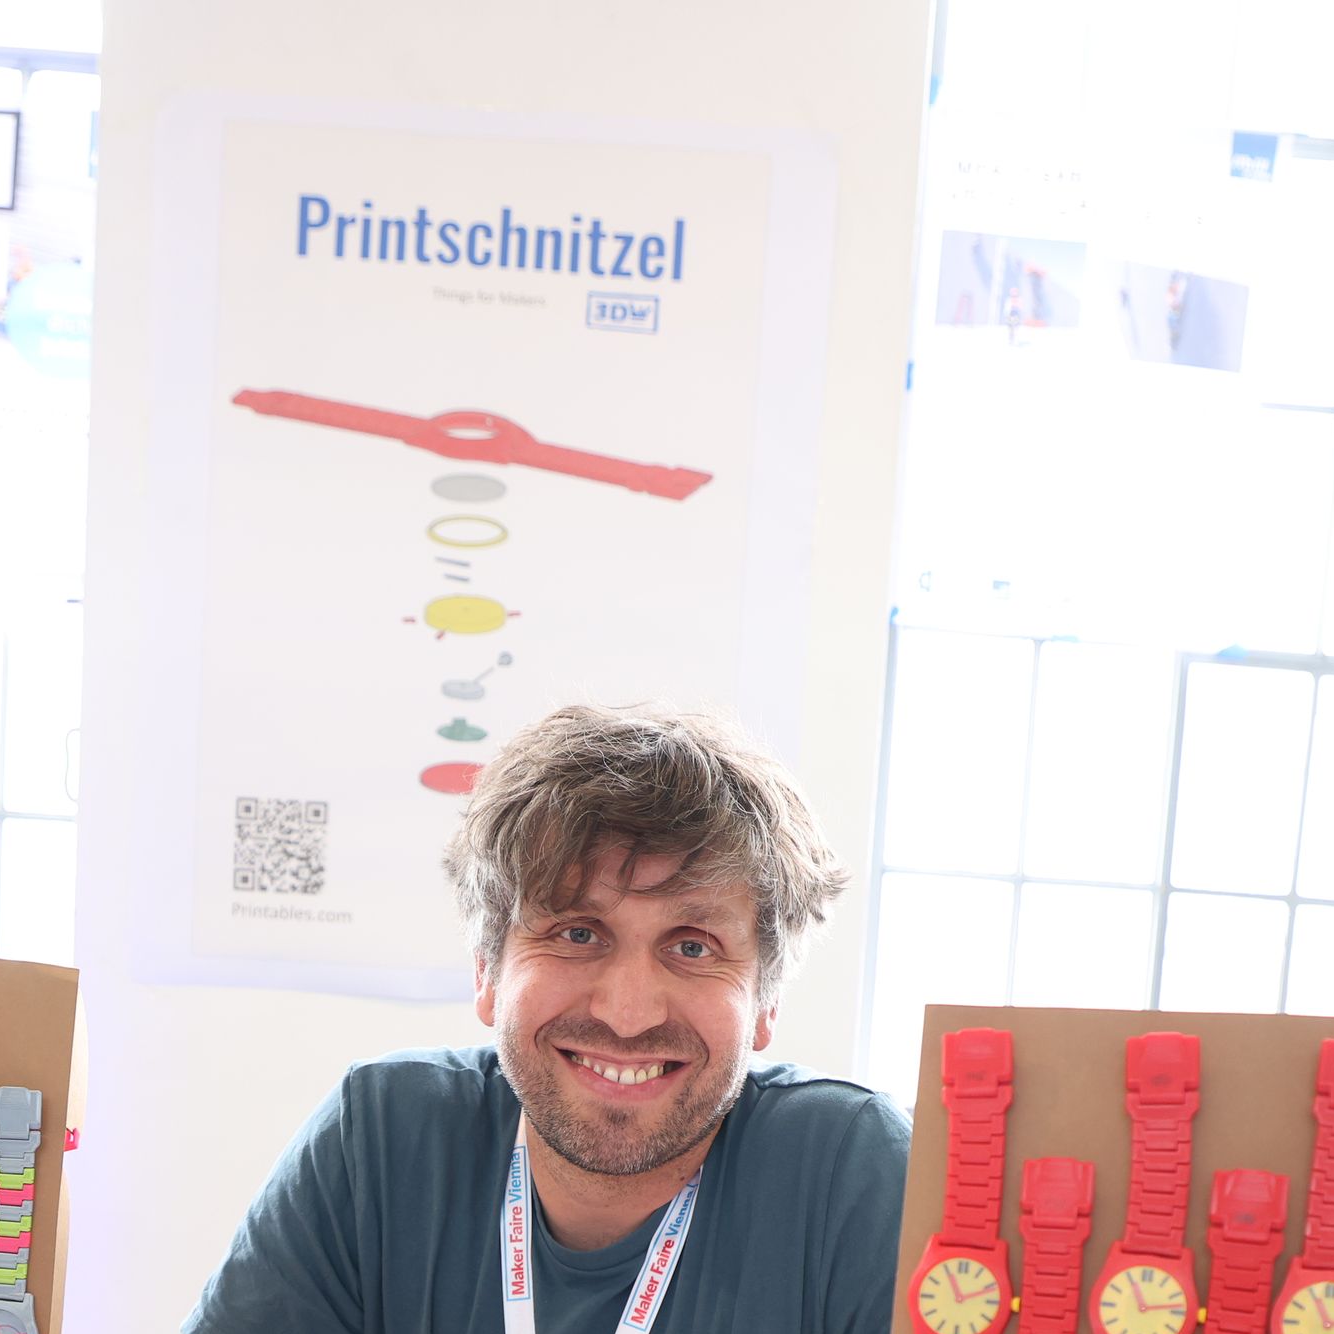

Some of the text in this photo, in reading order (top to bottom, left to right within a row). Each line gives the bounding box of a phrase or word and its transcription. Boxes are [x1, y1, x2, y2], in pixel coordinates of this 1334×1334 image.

[297, 193, 685, 281] Printschnitzel
[231, 902, 353, 924] Printables.com
[509, 1152, 525, 1296] Maker Faire Vienna
[630, 1190, 693, 1324] Maker Faire Vienna
